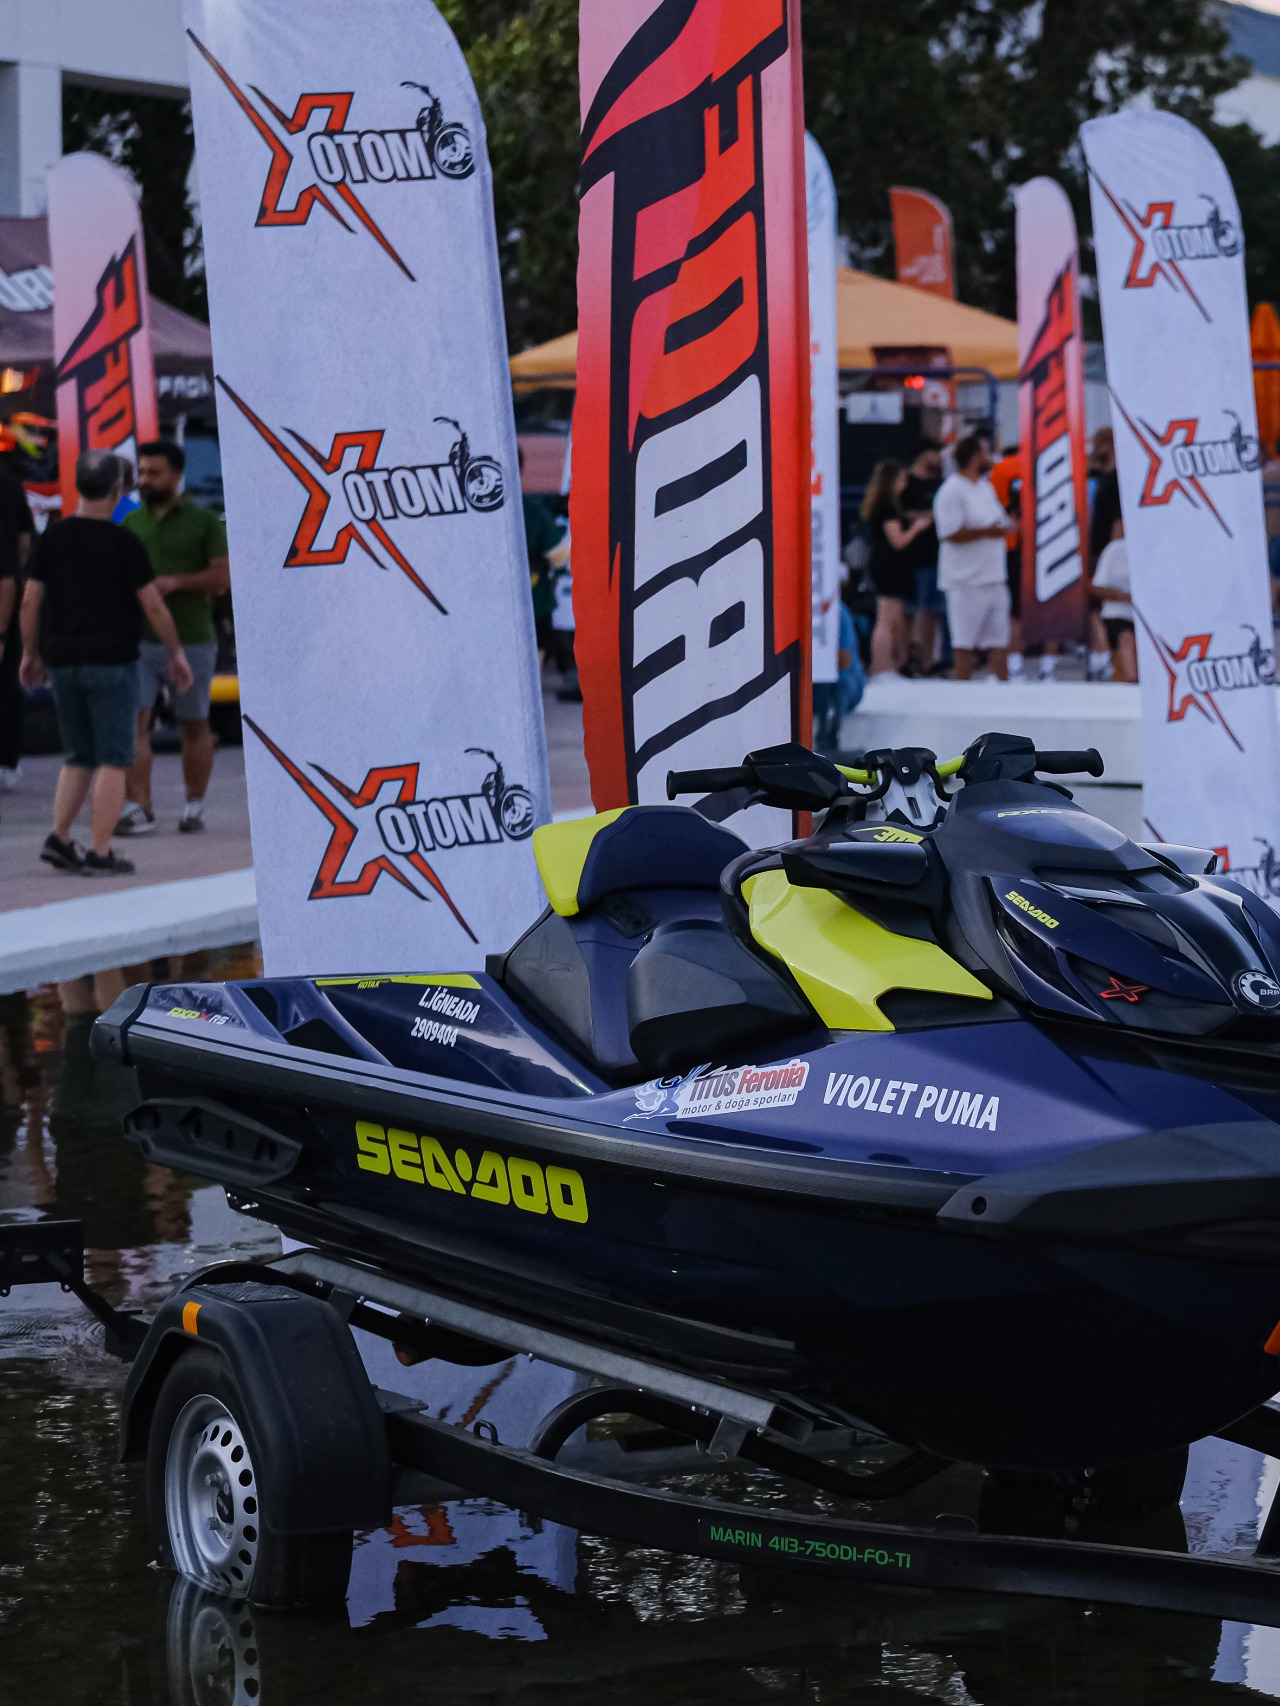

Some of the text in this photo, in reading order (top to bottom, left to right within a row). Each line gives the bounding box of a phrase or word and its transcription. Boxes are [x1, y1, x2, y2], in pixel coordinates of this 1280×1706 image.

[1260, 988, 1280, 997] BRP
[411, 1017, 459, 1048] 2909404
[737, 1063, 806, 1094] Feronia
[681, 1092, 796, 1115] motor & doğa sporları
[823, 1072, 1000, 1131] VIOLET PUMA
[710, 1525, 762, 1548] MARIN
